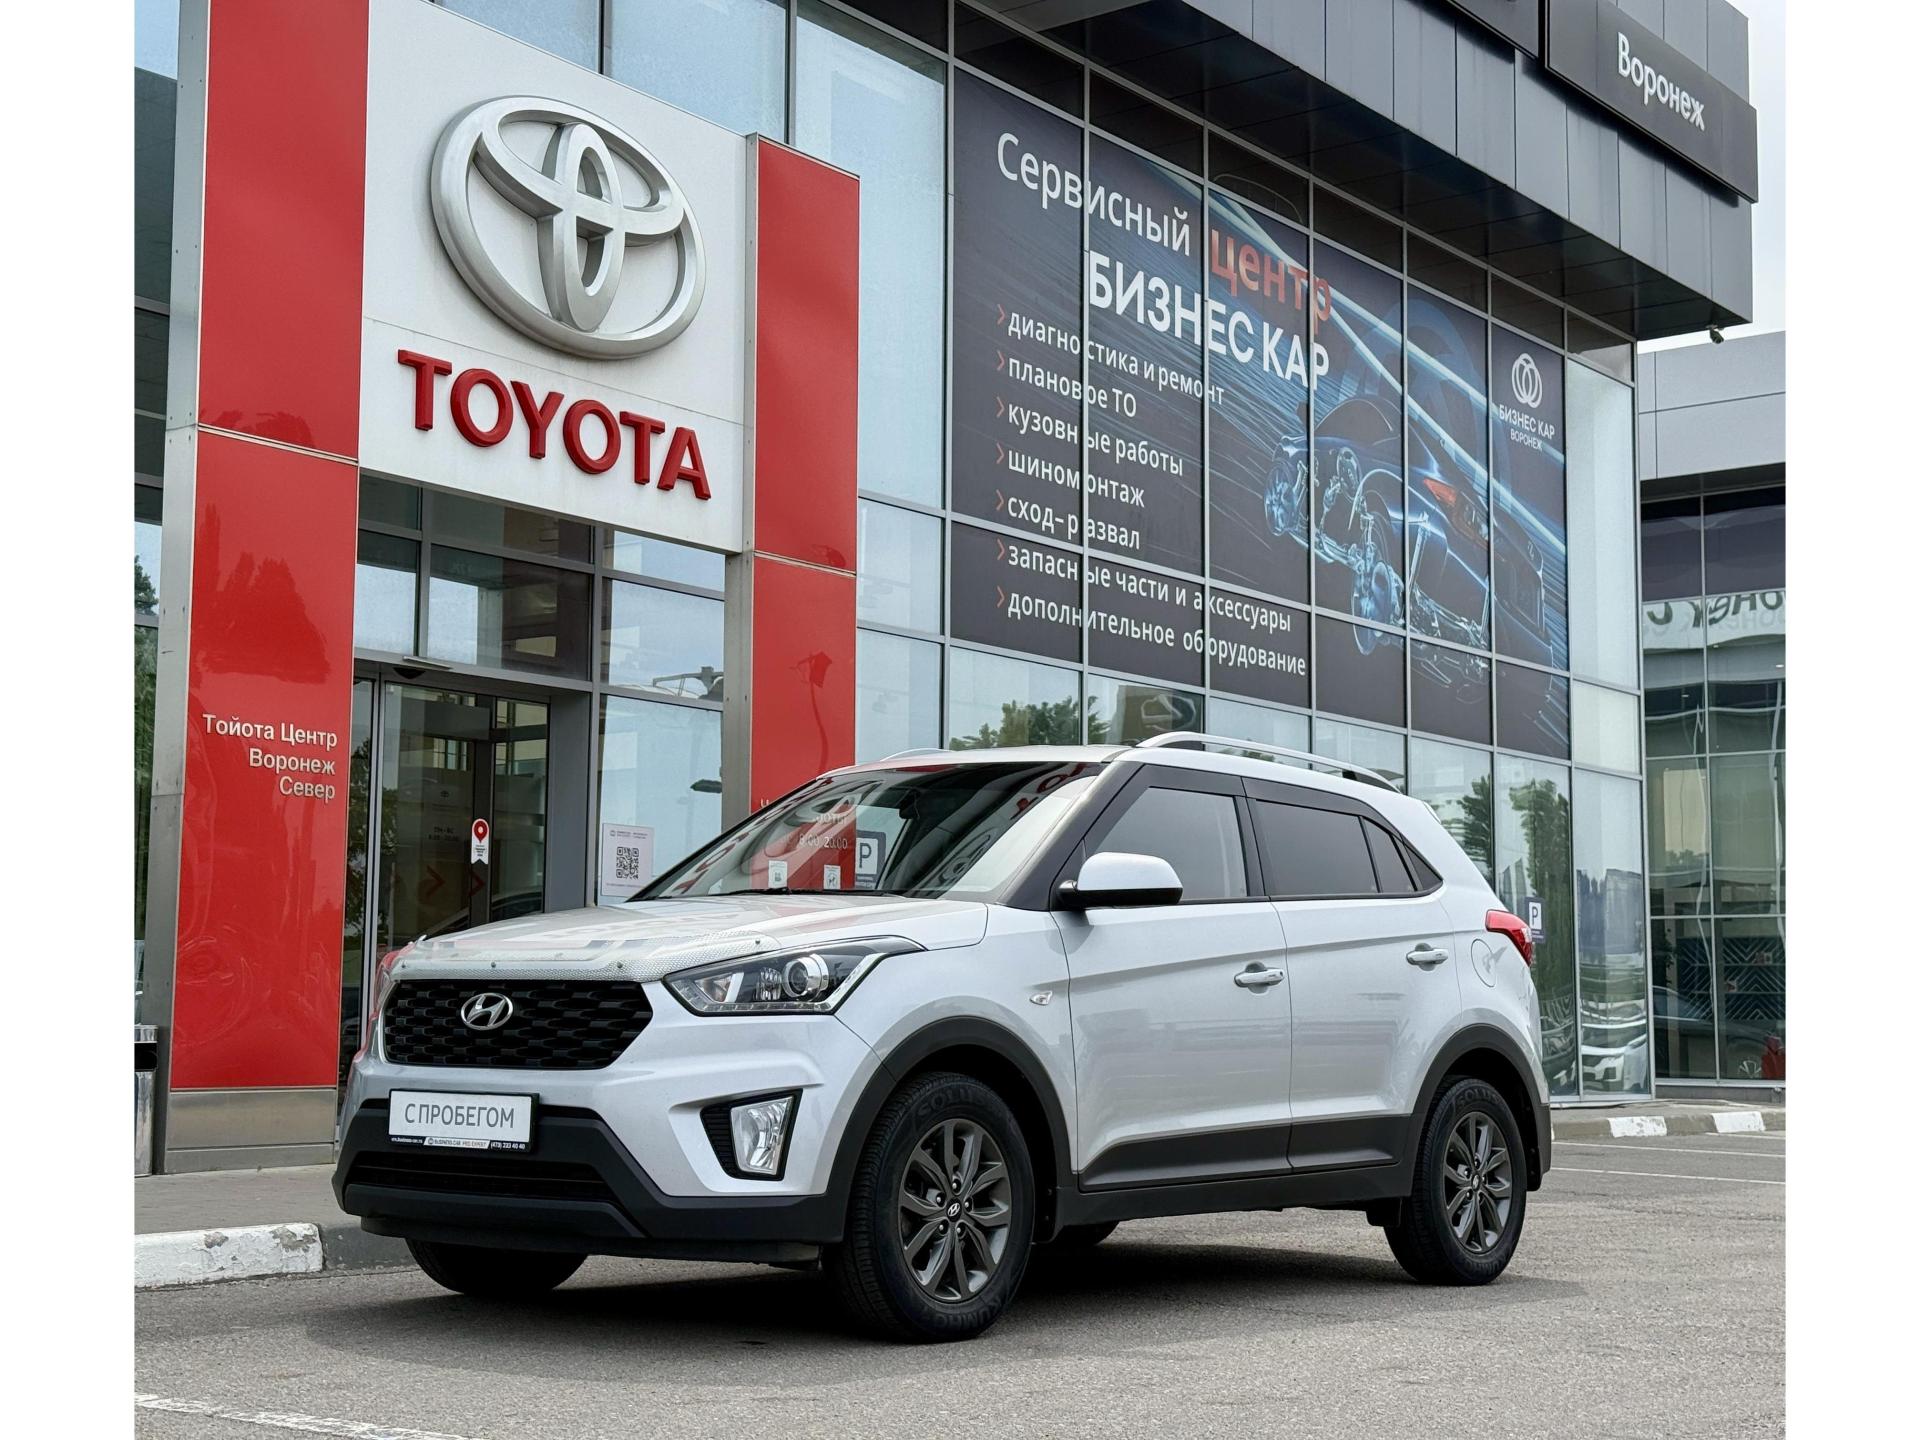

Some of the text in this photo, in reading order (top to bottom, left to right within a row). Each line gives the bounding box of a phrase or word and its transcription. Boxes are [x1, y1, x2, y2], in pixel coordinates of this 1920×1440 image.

[1617, 31, 1706, 132] Воронеж
[997, 132, 1332, 335] Сервисный центр
[1090, 250, 1330, 392] БИЗНЕС КАР
[1008, 311, 1224, 406] диагностика и ремонт
[1008, 357, 1137, 418] плановое ТО
[398, 349, 711, 501] TOYOTA
[1008, 404, 1183, 477] кузовные работы
[1499, 404, 1555, 440] БИЗНЕС КАР
[1510, 428, 1543, 452] ВОРОНЕЖ
[1008, 449, 1145, 508] шиномонтаж
[1008, 545, 1291, 636] запасные части и аксессуары
[1007, 591, 1306, 676] дополнительное оборудование
[202, 713, 338, 751] Тойота Центр
[249, 747, 336, 775] Воронеж
[279, 775, 336, 803] Север
[858, 842, 872, 869] P
[1531, 906, 1539, 926] P
[404, 1103, 515, 1129] С ПРОБЕГОМ
